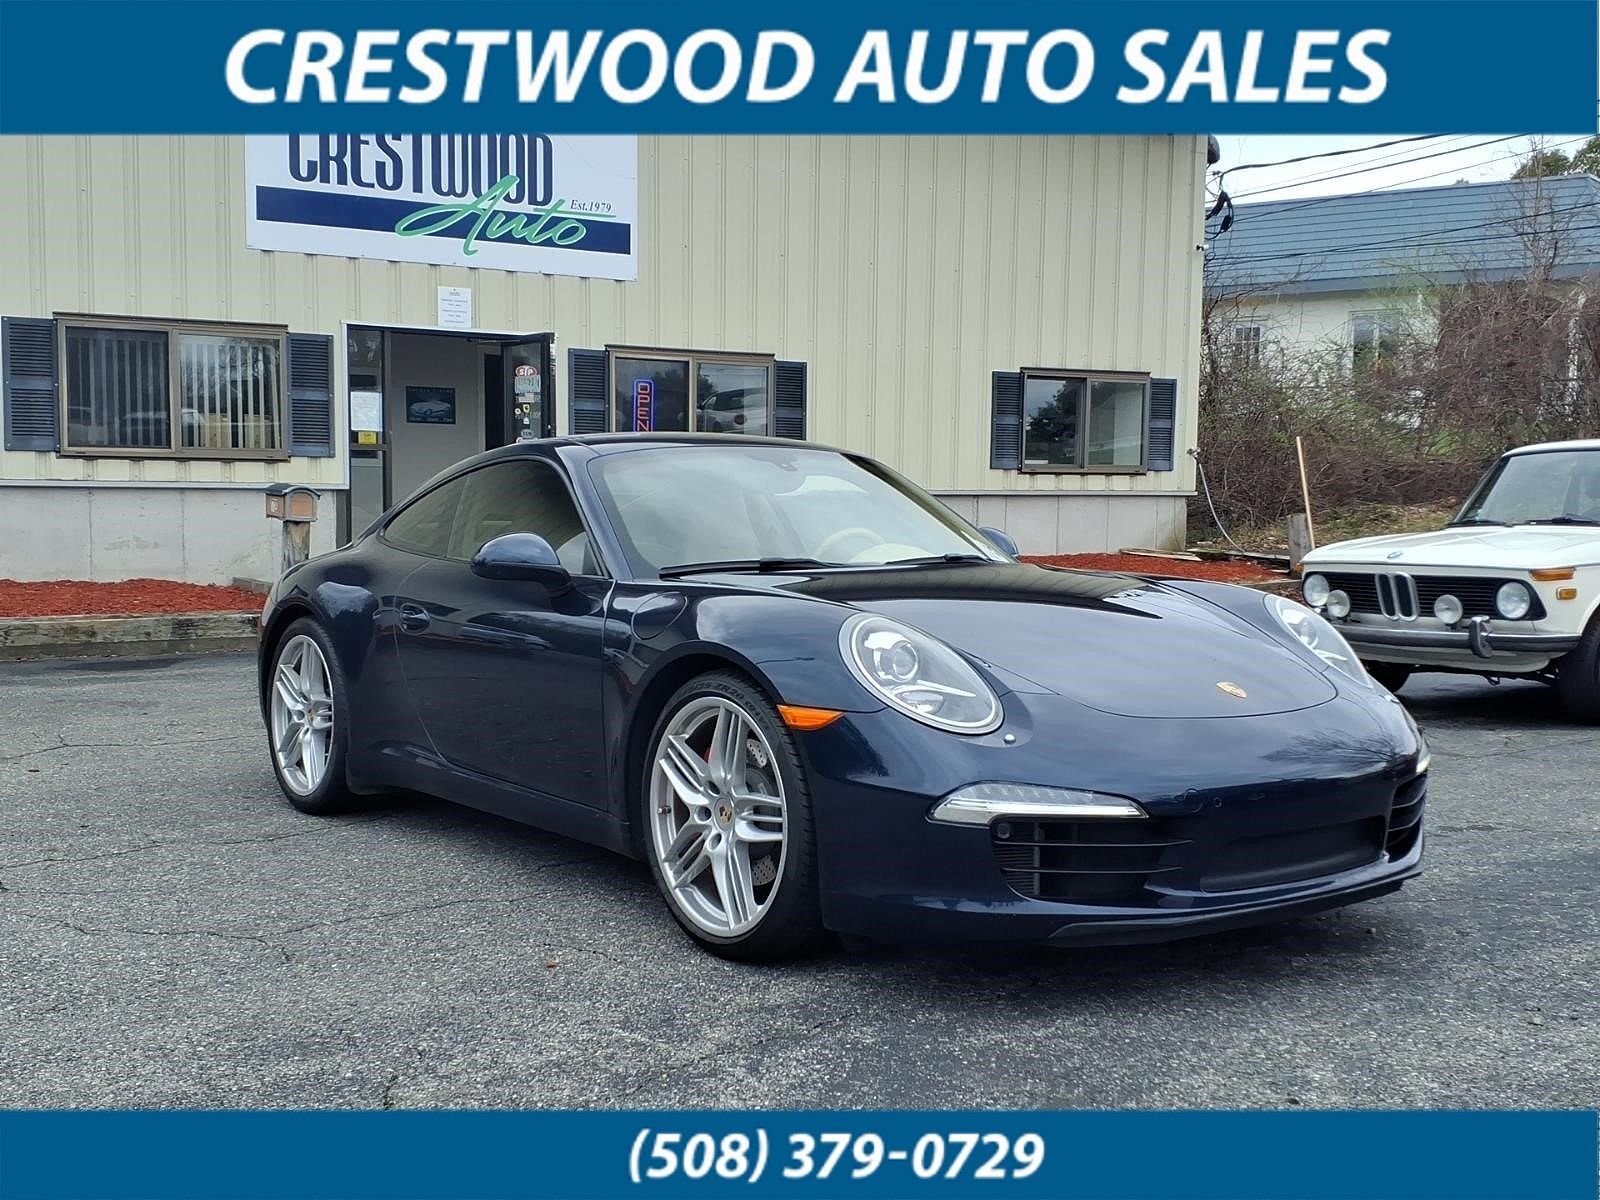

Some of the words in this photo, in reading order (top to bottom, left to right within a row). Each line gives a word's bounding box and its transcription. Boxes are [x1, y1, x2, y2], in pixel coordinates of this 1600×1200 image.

[288, 133, 553, 207] CRESTWOOD
[395, 175, 616, 256] Auto
[638, 382, 651, 432] OPEN
